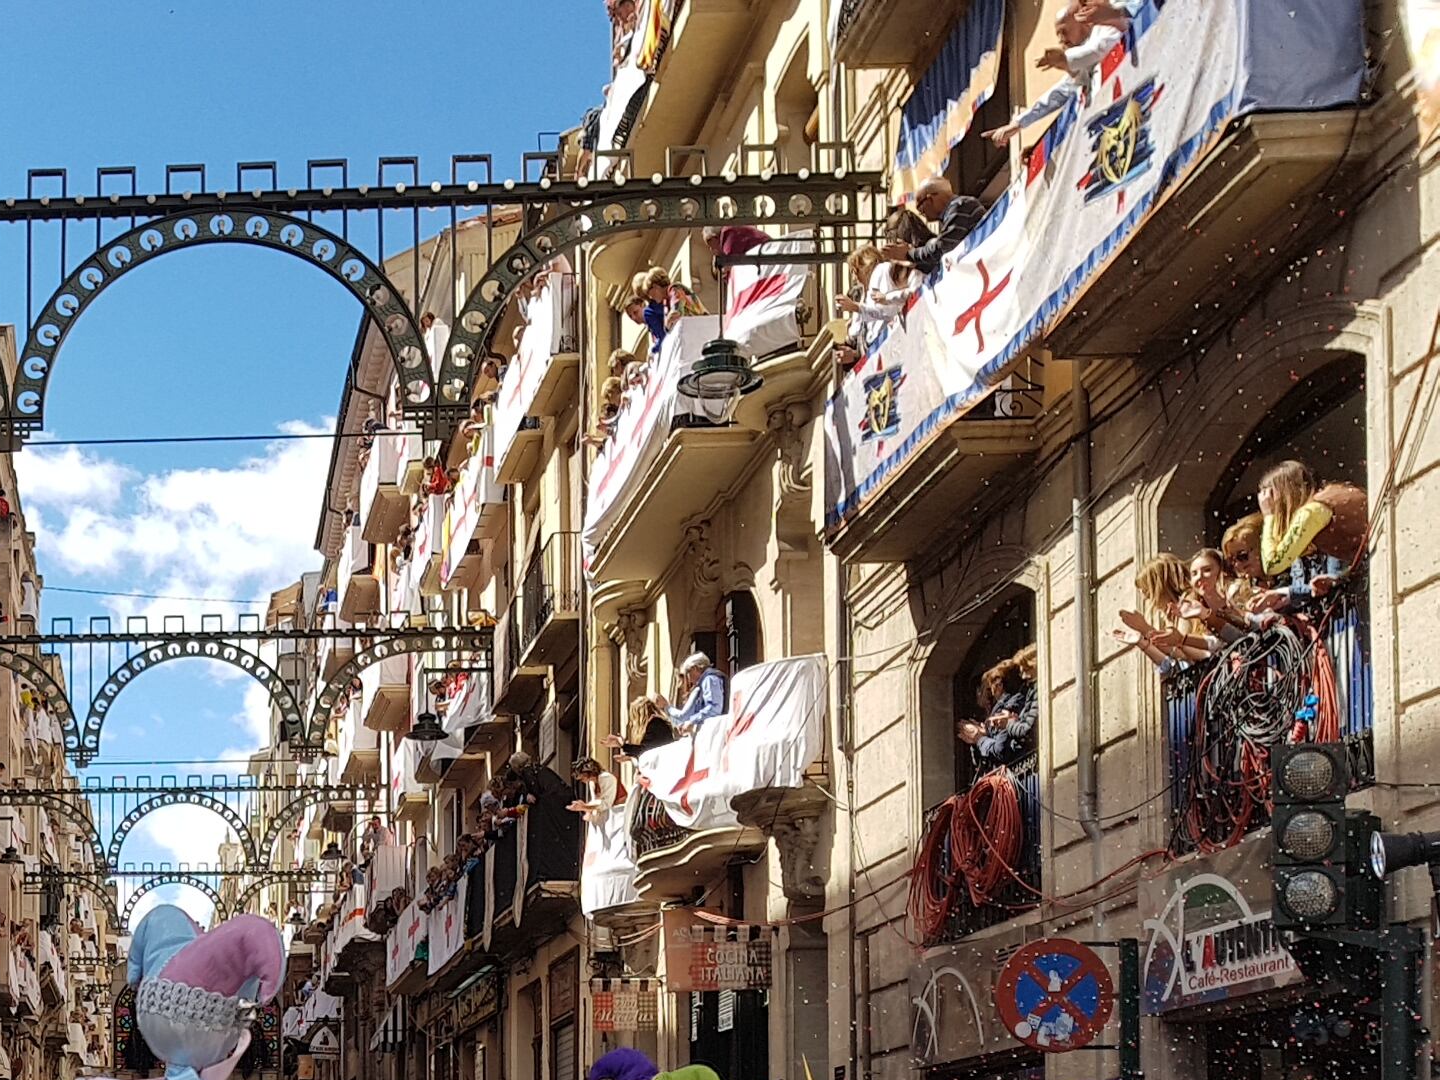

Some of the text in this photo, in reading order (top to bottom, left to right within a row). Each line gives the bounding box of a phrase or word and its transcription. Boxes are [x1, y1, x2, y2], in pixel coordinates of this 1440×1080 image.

[705, 948, 759, 965] COCINA
[700, 965, 767, 983] ITALIANA
[1187, 955, 1291, 991] Café-Restaurant
